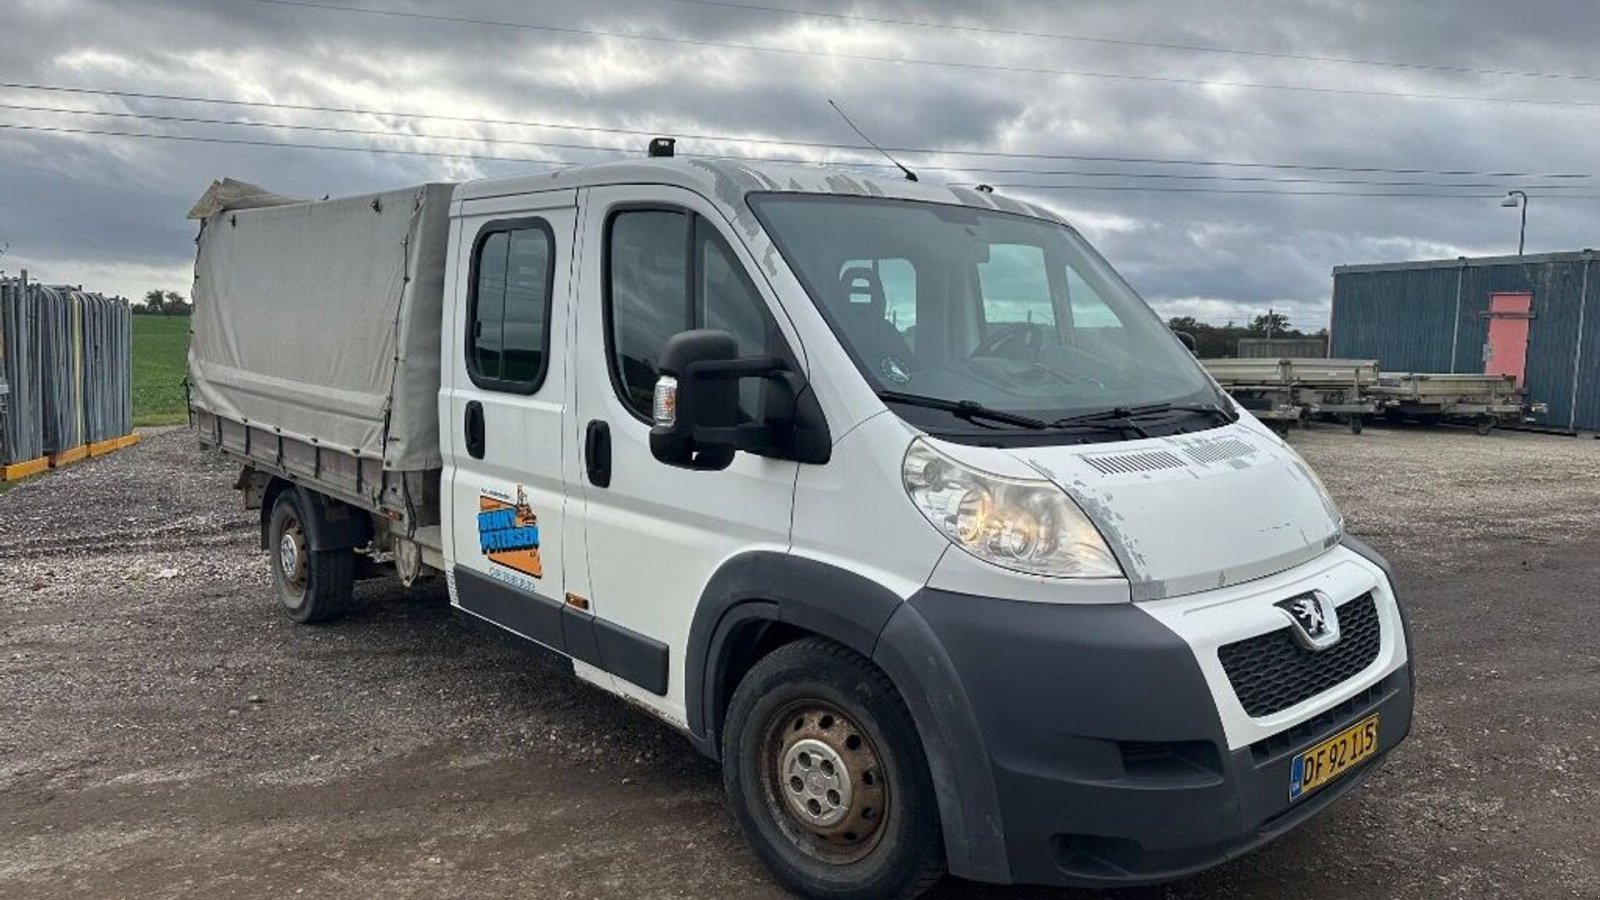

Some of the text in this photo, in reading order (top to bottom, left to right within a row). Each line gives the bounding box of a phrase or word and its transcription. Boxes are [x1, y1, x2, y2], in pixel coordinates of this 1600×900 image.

[480, 526, 539, 553] PETERSEN
[1304, 722, 1374, 786] DF 92 115
